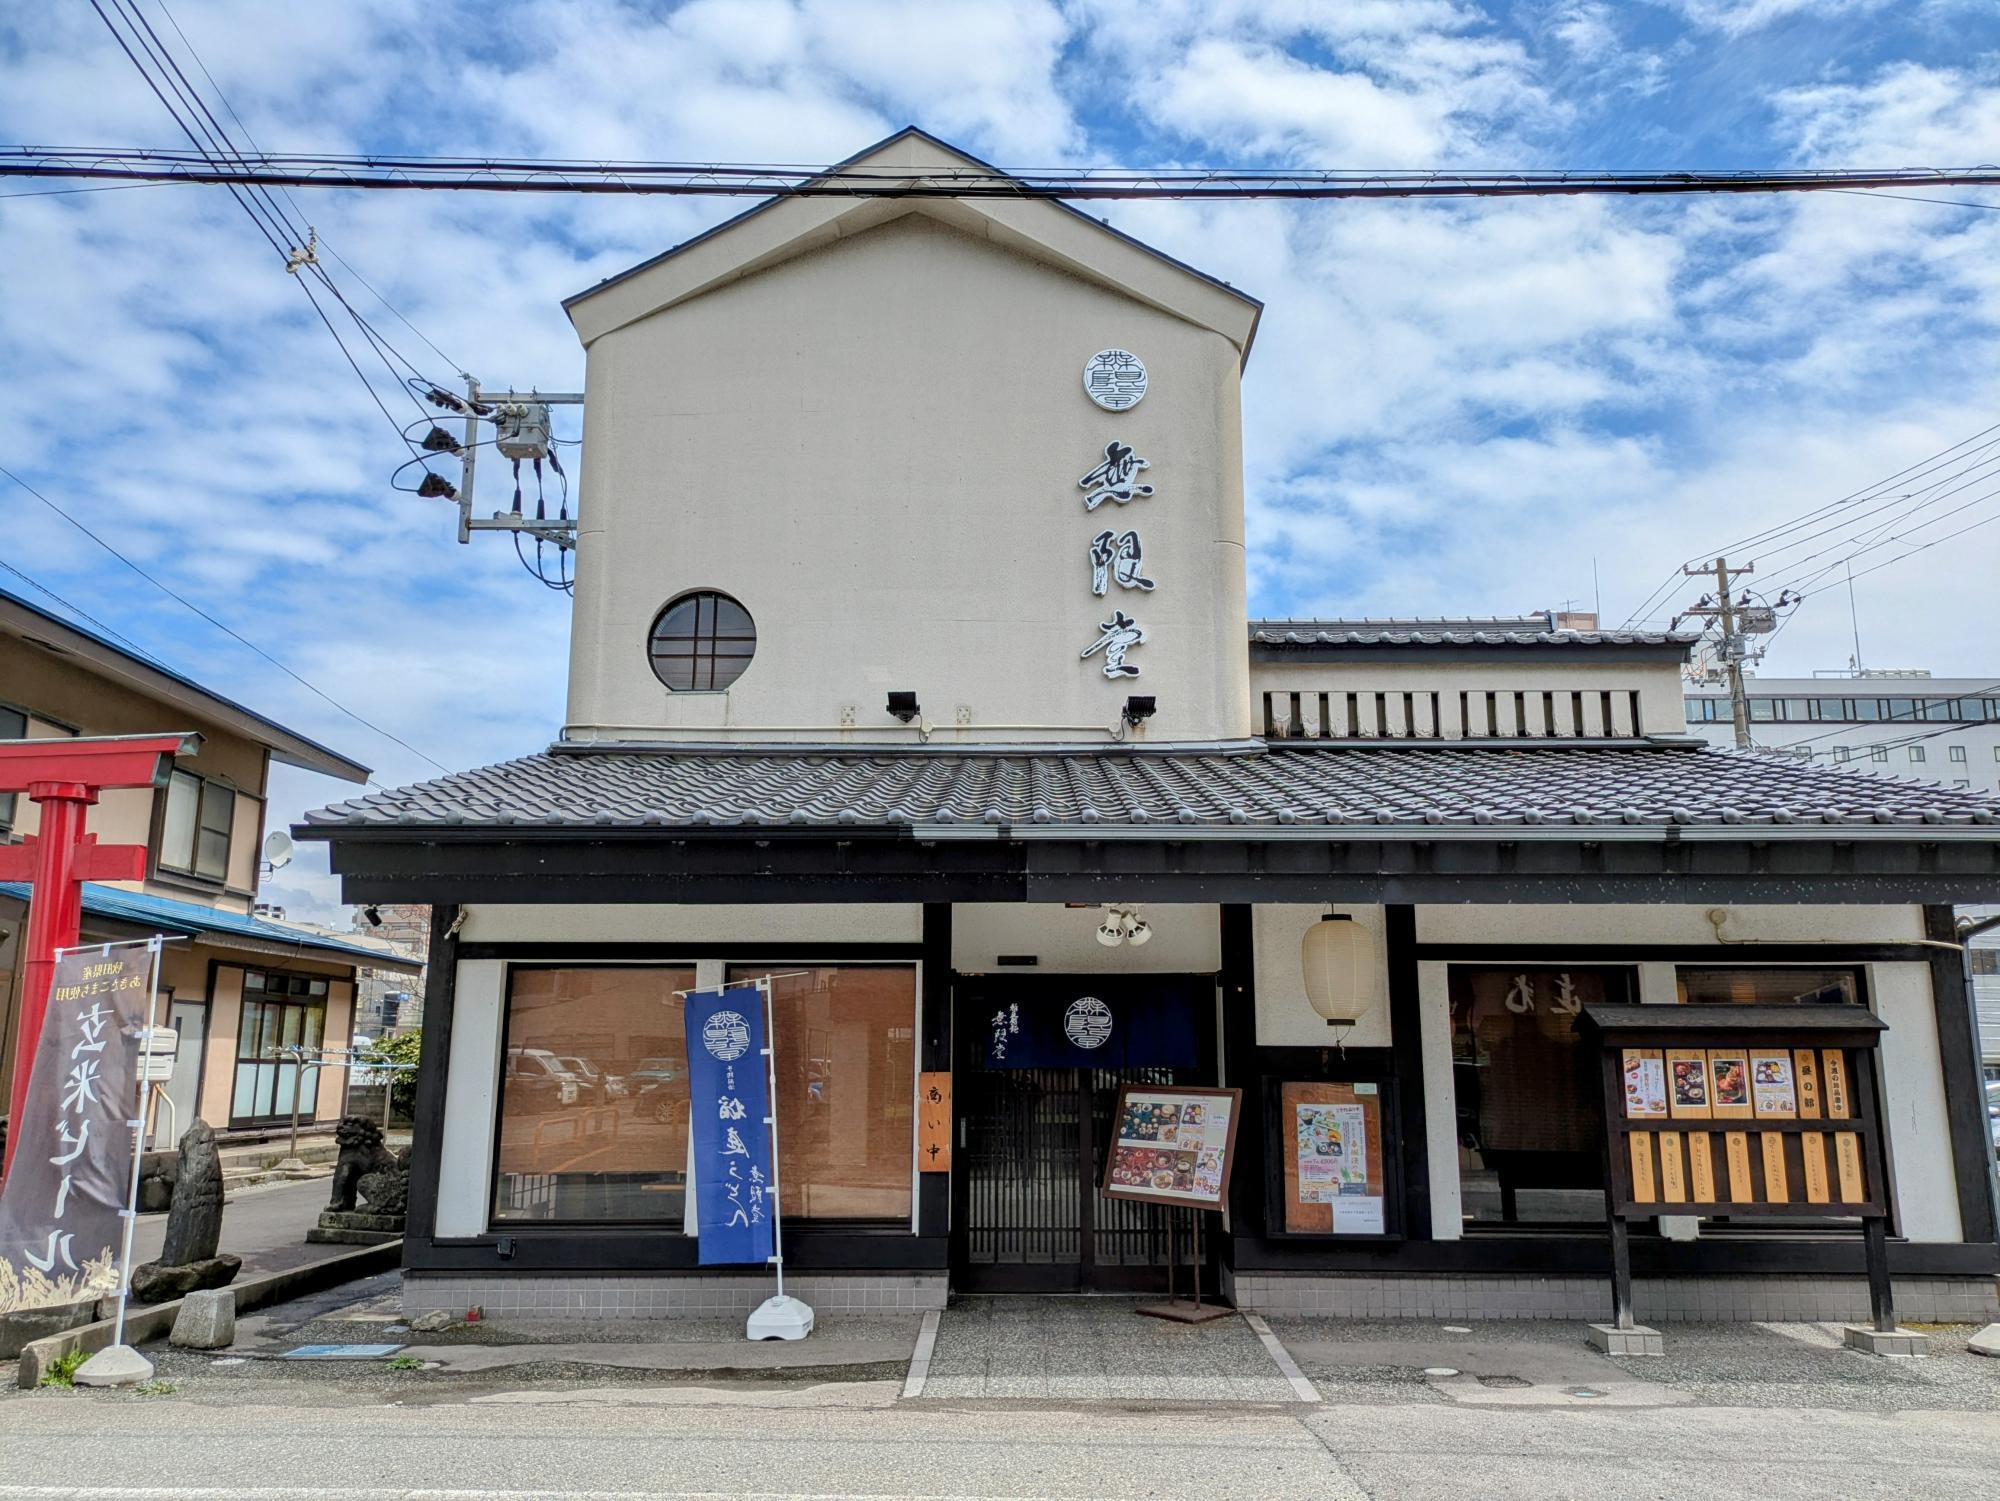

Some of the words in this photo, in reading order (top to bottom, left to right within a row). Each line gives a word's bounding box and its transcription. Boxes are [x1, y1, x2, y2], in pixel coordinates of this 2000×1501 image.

[1079, 440, 1156, 682] 無限堂
[926, 1086, 942, 1162] 商い中
